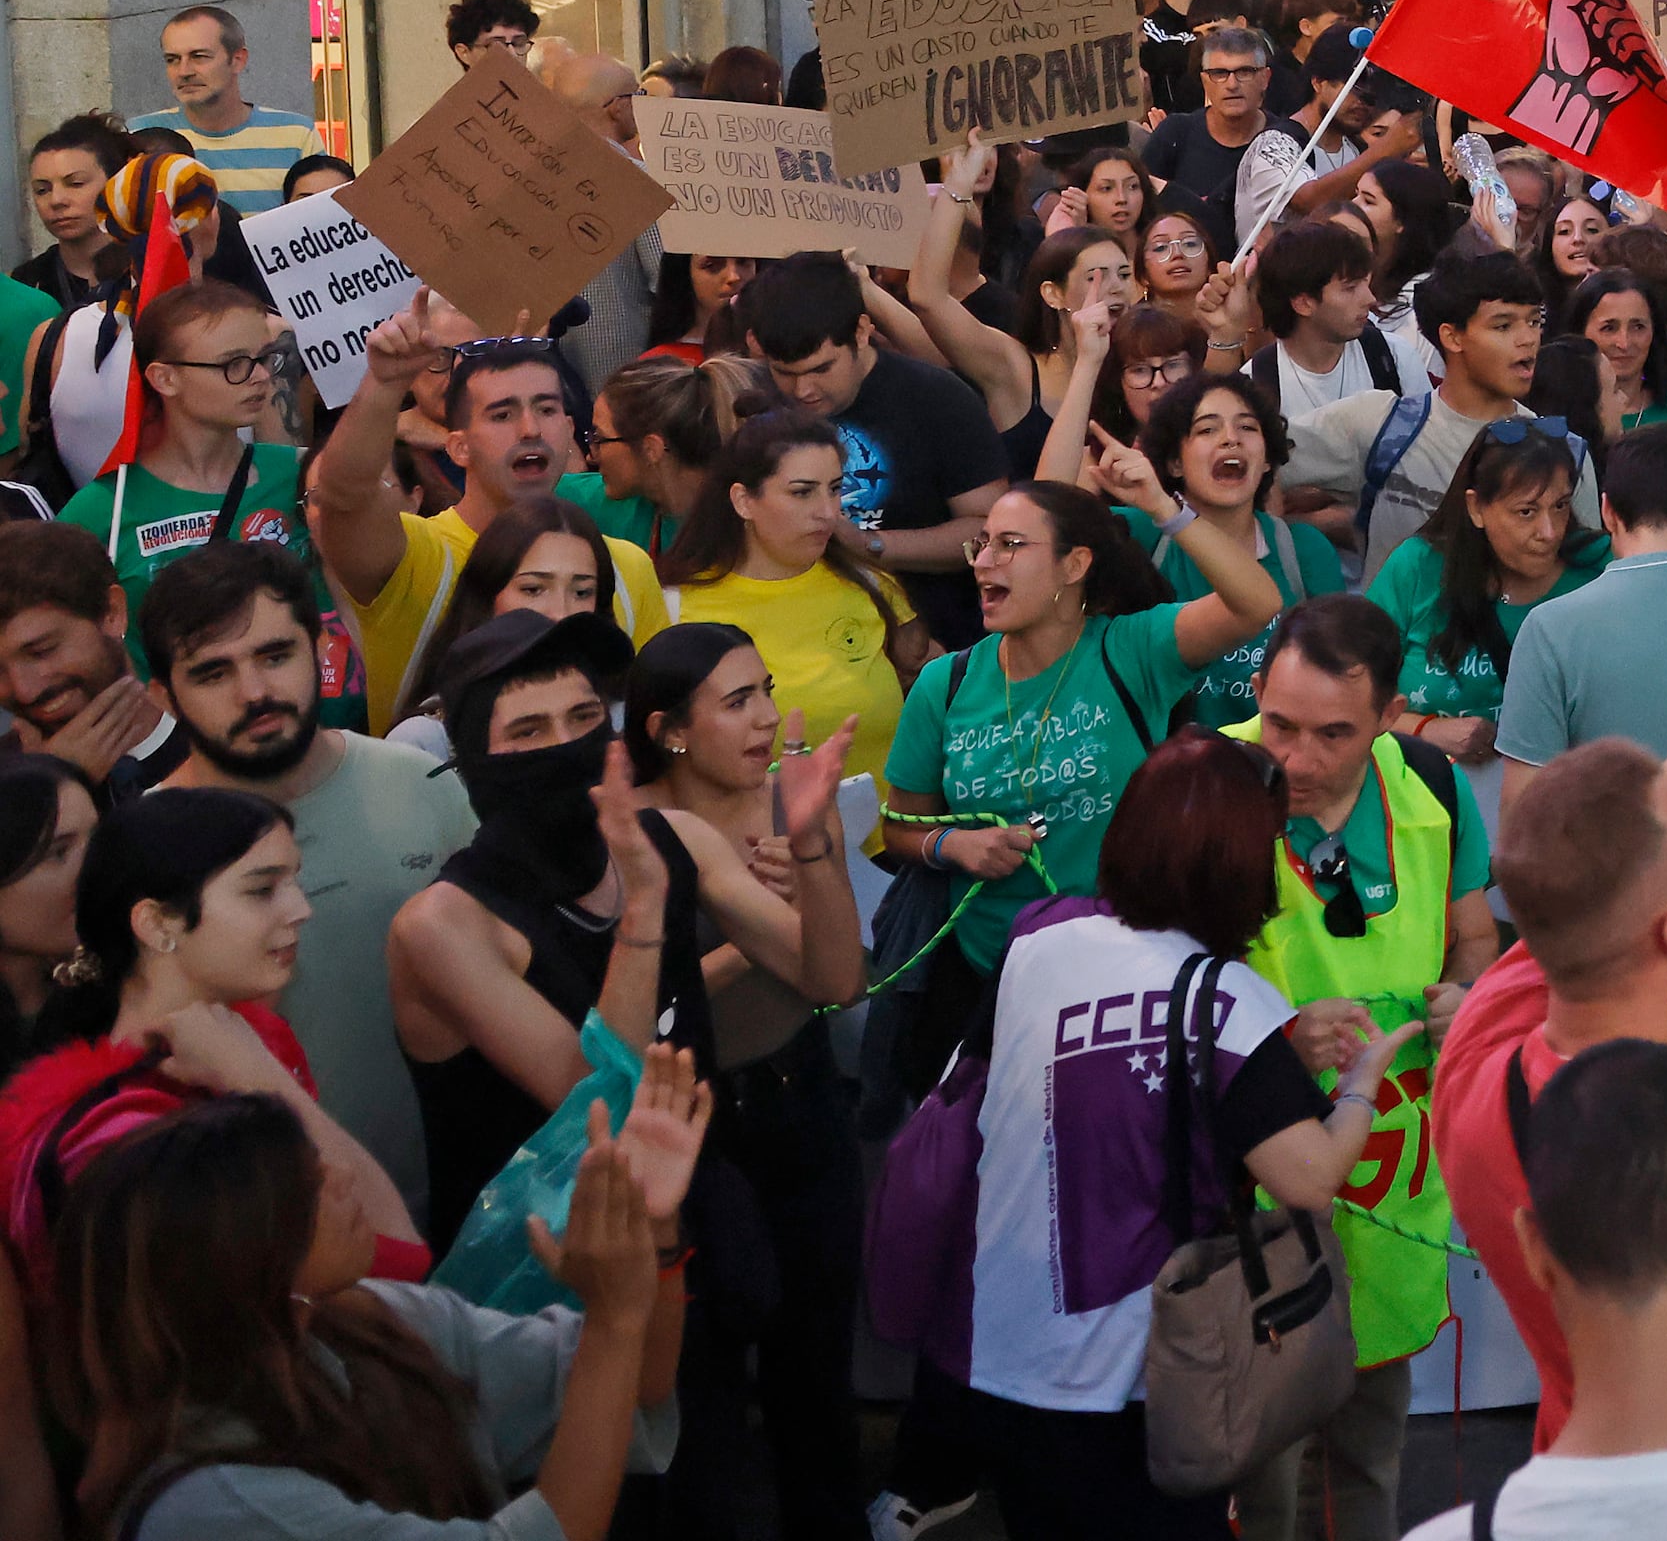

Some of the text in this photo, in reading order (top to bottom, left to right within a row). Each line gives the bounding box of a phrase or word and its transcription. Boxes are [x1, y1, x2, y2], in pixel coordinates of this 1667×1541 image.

[828, 54, 861, 85] ES
[875, 44, 905, 70] UN
[989, 21, 1059, 48] CUANDO
[1068, 15, 1097, 34] TE
[832, 75, 917, 116] QUIEREN
[660, 111, 708, 139] LA
[664, 147, 704, 173] ES
[716, 150, 769, 178] UN
[664, 183, 903, 231] NO UN PRODUCTO
[254, 244, 290, 276] La
[289, 290, 322, 320] un
[304, 340, 341, 371] no
[141, 516, 209, 540] IZQUIERDA
[947, 722, 1025, 753] ESCUELA
[955, 756, 1098, 801] DE TOD@S
[1043, 791, 1113, 823] OD@S
[1365, 885, 1393, 899] UGT
[1054, 990, 1238, 1056] CCOO
